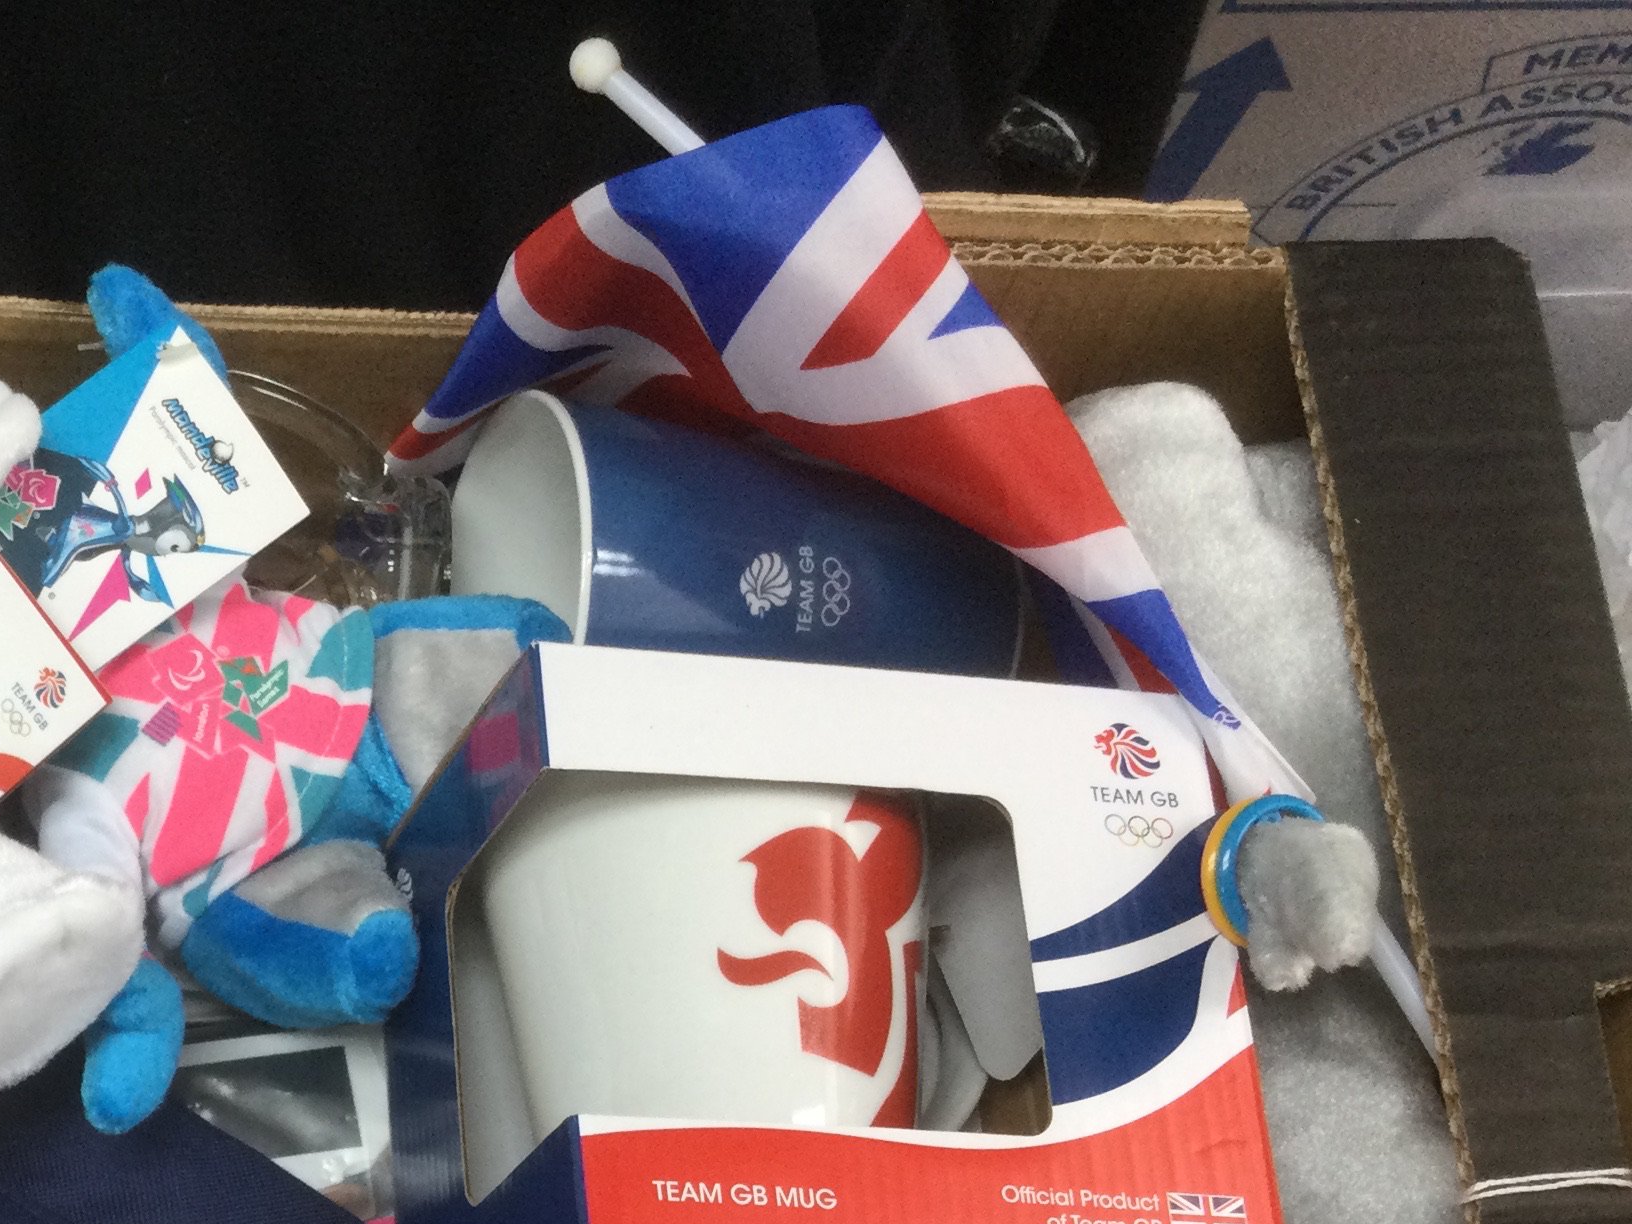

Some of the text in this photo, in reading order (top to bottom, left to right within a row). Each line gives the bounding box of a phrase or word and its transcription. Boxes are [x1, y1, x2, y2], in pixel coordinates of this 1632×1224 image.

[1286, 107, 1466, 211] BRITISH
[795, 545, 814, 633] TEAM GB
[11, 682, 49, 731] TEAM GB
[1090, 786, 1179, 808] TEAM GB
[652, 1180, 838, 1210] TEAM GB MUG
[1001, 1184, 1160, 1212] Official Product
